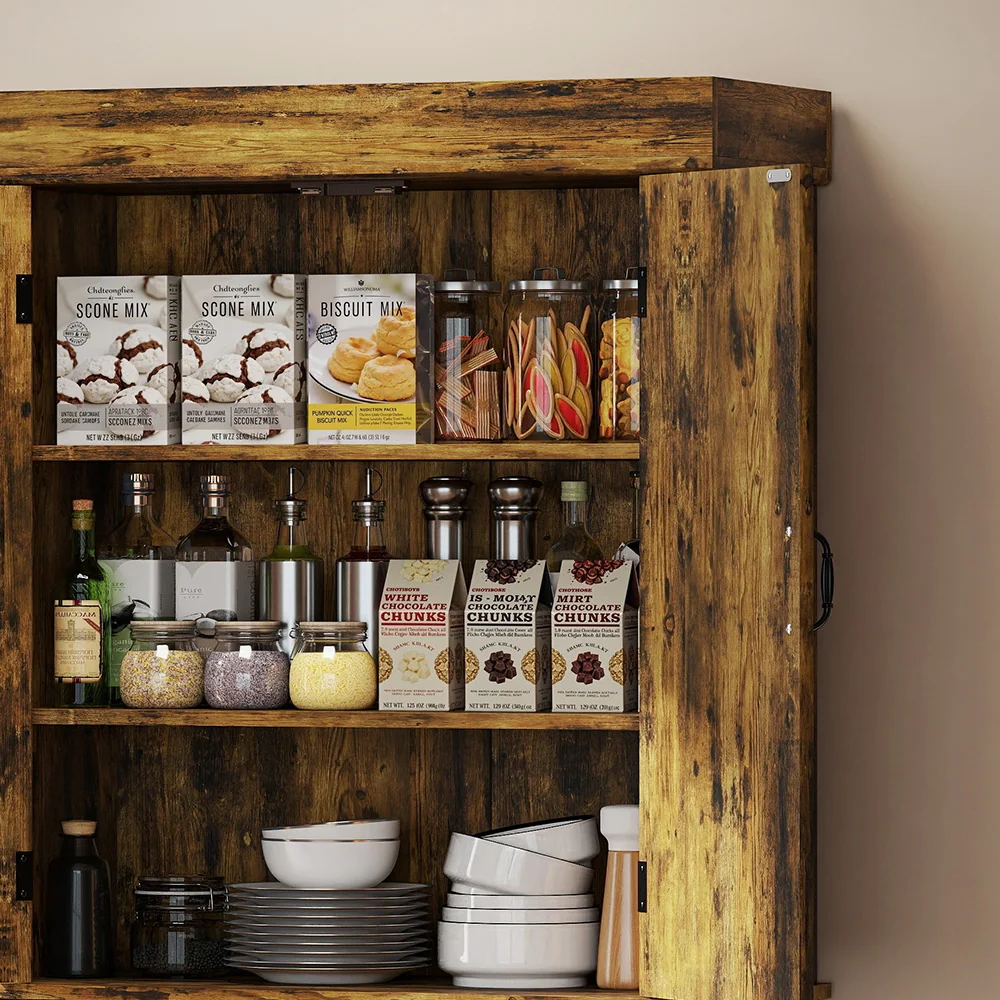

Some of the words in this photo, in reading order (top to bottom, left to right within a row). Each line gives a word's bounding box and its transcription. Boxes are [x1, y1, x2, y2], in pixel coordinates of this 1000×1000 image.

[77, 303, 119, 318] SCONE
[125, 303, 148, 318] MIX
[202, 302, 244, 317] SCONE
[251, 302, 275, 317] MIX
[321, 302, 373, 317] BISCUIT
[381, 301, 403, 316] MIX
[557, 595, 593, 603] MIRT
[381, 612, 446, 621] CHUNKS
[467, 612, 533, 622] CHUNKS
[554, 613, 620, 622] CHUNKS
